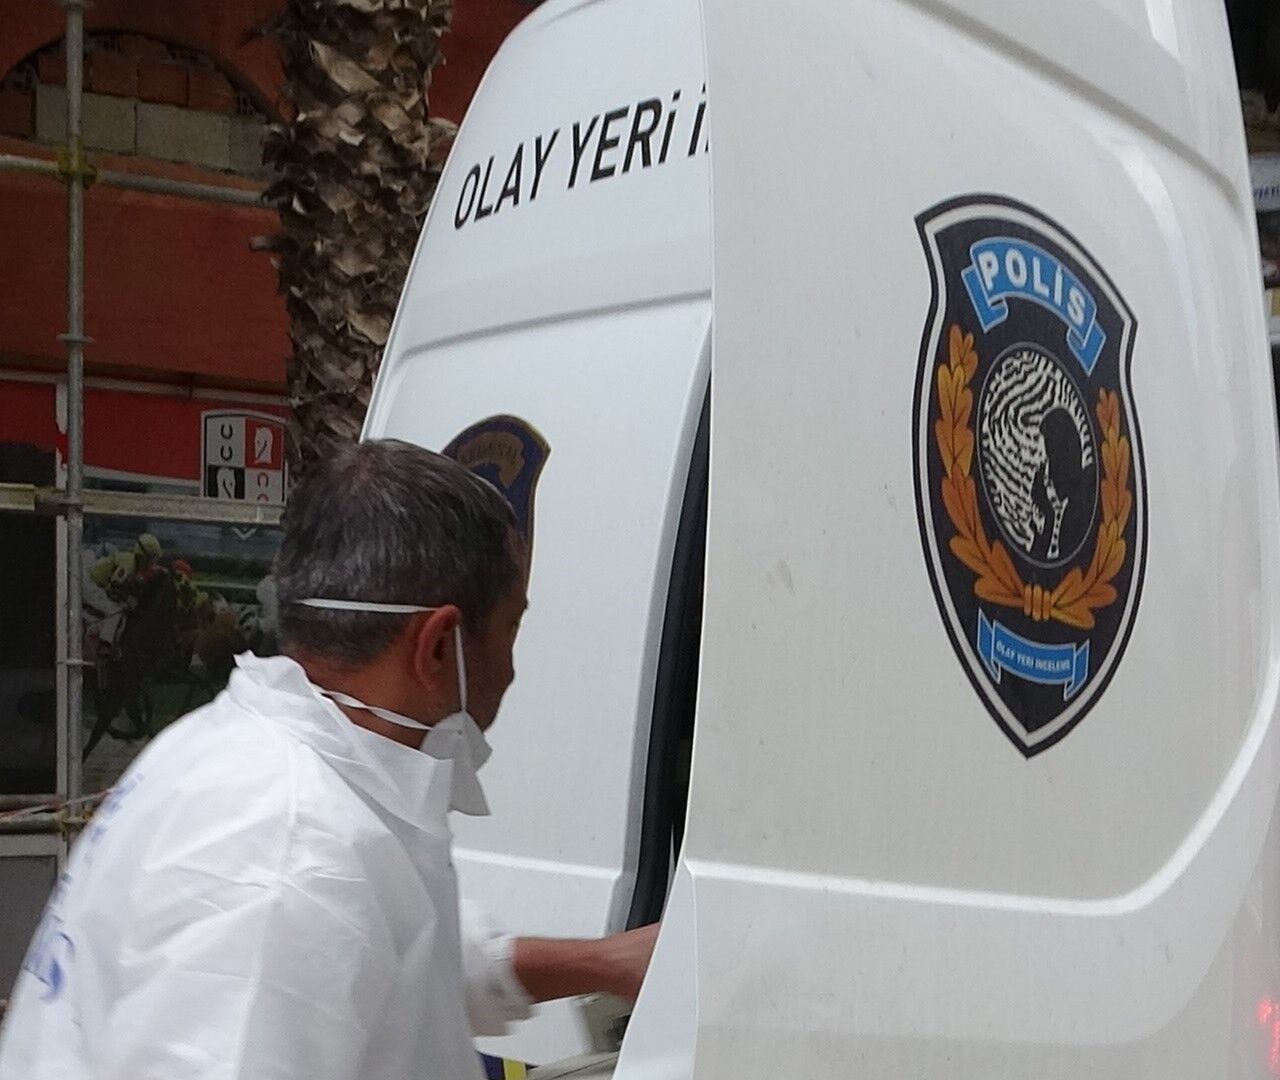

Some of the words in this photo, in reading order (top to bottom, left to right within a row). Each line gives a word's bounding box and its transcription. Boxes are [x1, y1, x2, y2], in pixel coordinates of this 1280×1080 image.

[453, 128, 561, 231] OLAY
[567, 88, 682, 190] YERİ
[977, 247, 1087, 327] POLİS
